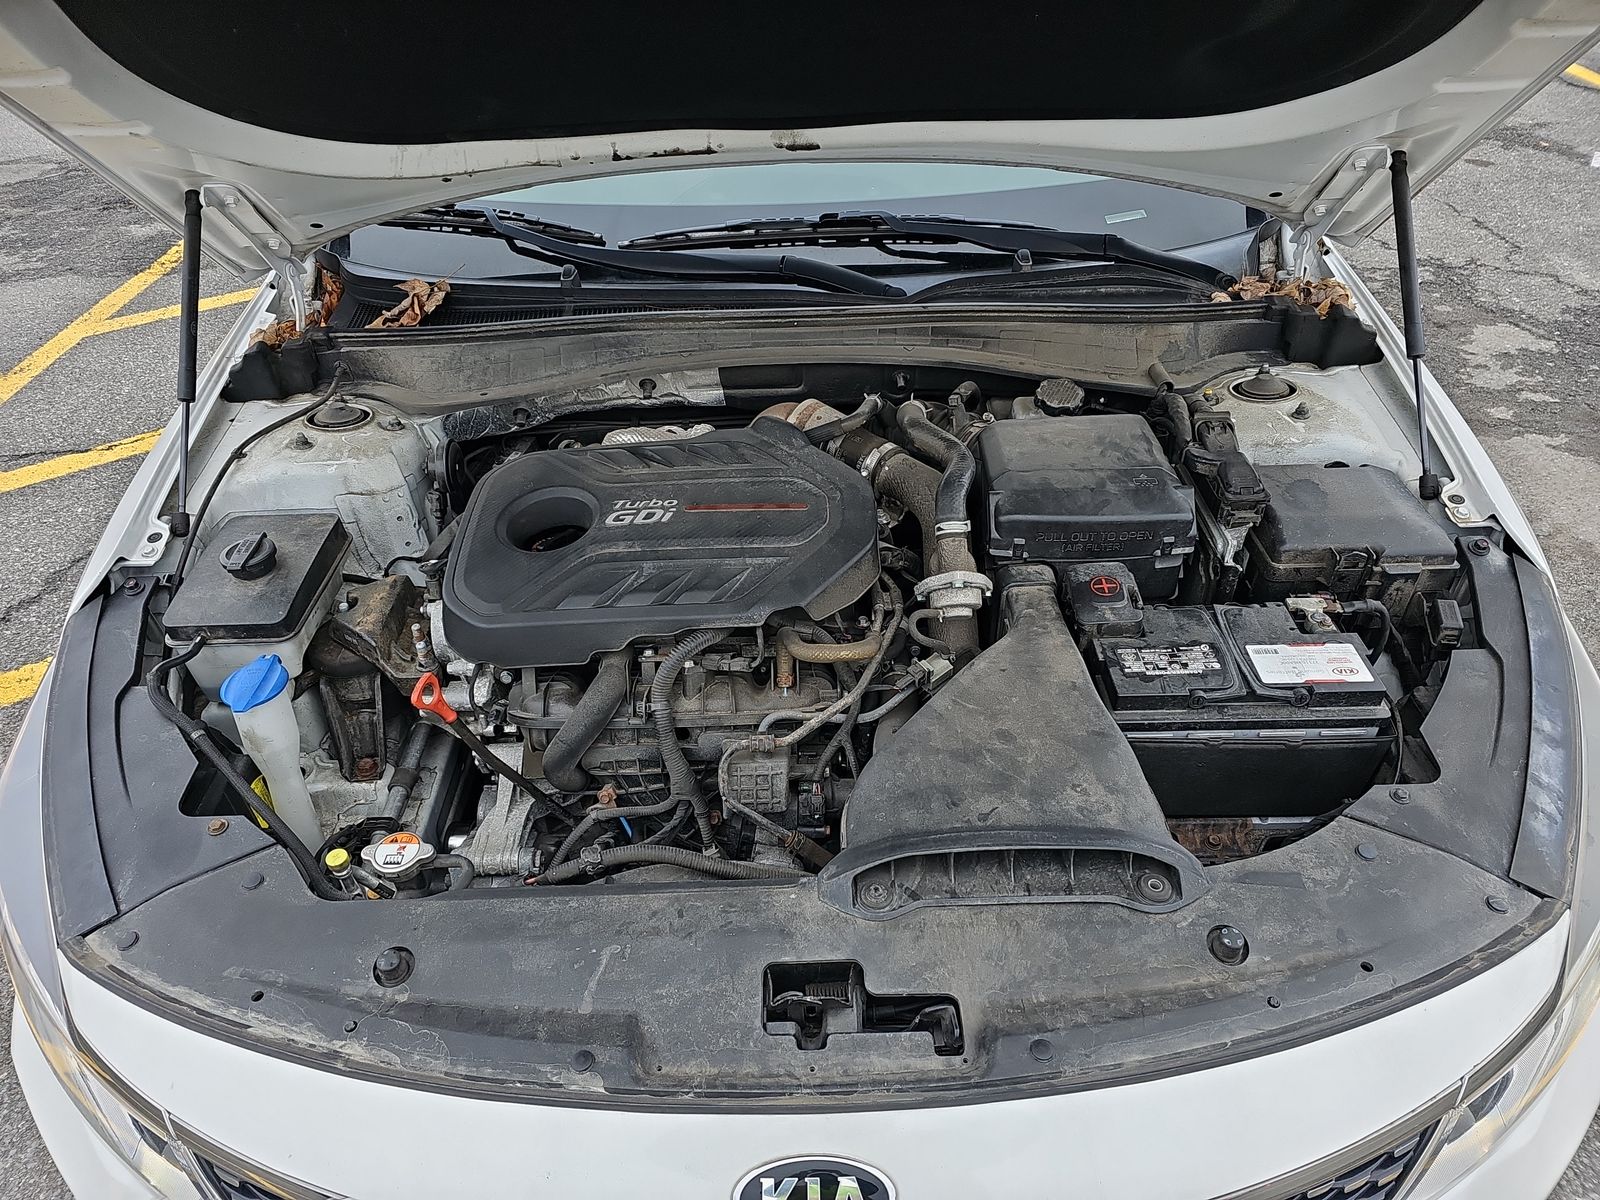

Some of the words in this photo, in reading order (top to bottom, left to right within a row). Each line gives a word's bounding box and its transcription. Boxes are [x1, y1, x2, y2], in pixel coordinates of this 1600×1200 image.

[611, 499, 678, 509] Turbo
[605, 508, 677, 525] GDi
[1035, 532, 1067, 542] PULL
[1071, 532, 1098, 542] OUT
[1100, 532, 1116, 541] TO
[1120, 531, 1154, 541] OPEN
[1061, 543, 1084, 552] (AIR
[1086, 542, 1125, 551] FILTER)
[759, 1176, 865, 1200] KIA
